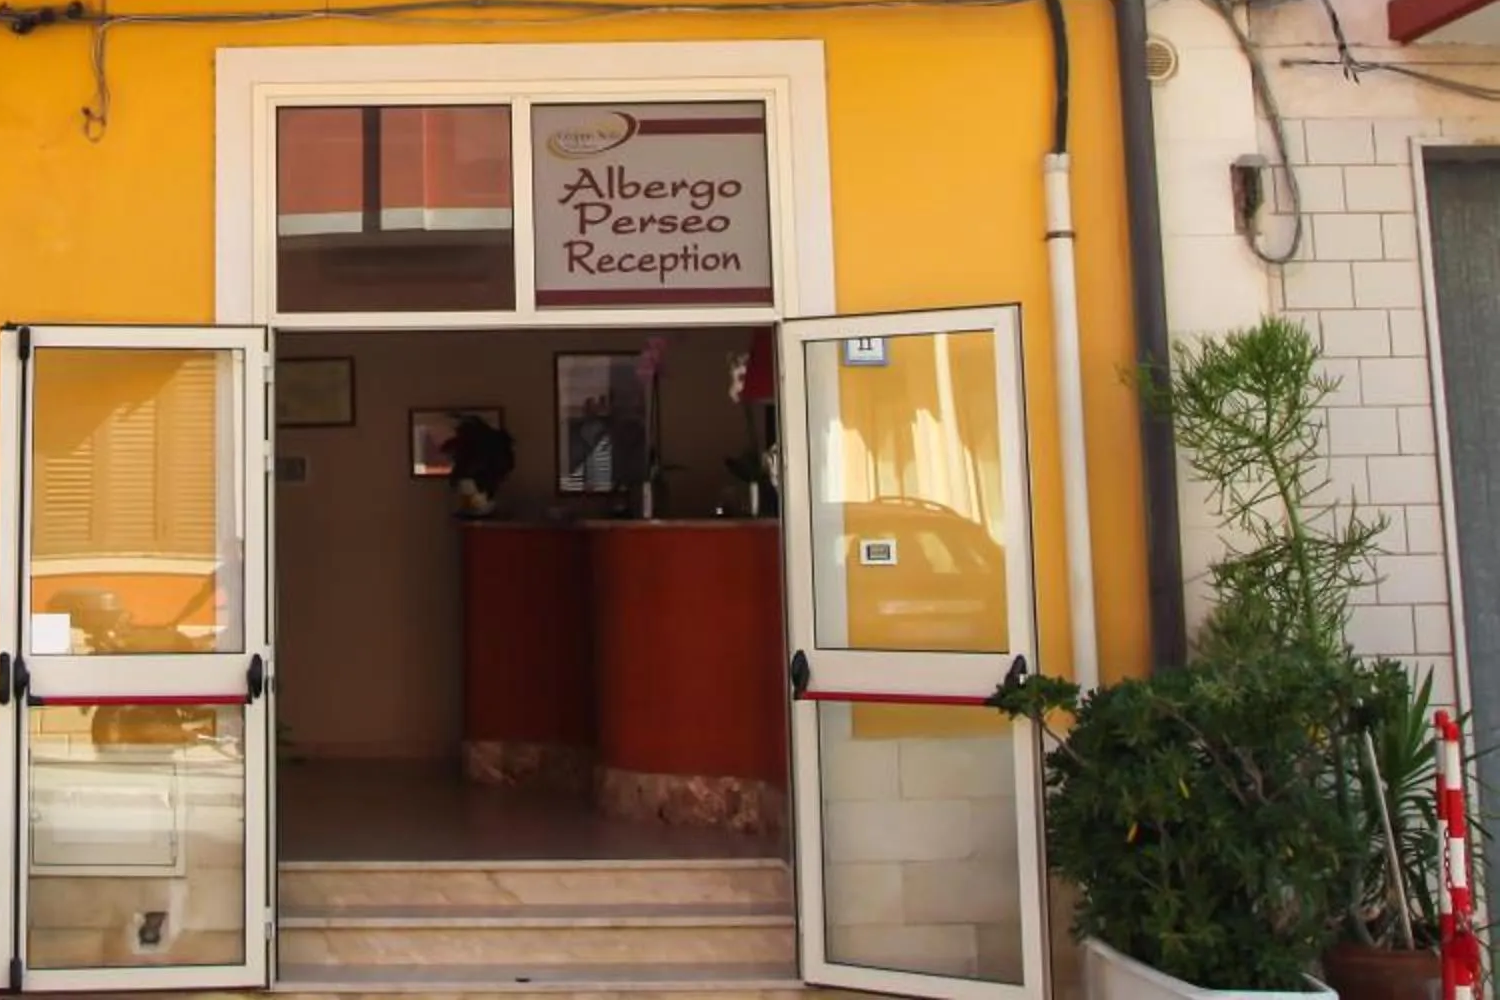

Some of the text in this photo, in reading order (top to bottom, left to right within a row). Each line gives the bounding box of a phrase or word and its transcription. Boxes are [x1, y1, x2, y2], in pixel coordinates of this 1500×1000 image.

[557, 165, 743, 211] Albergo
[573, 201, 731, 236] Perseo
[562, 239, 742, 285] Reception
